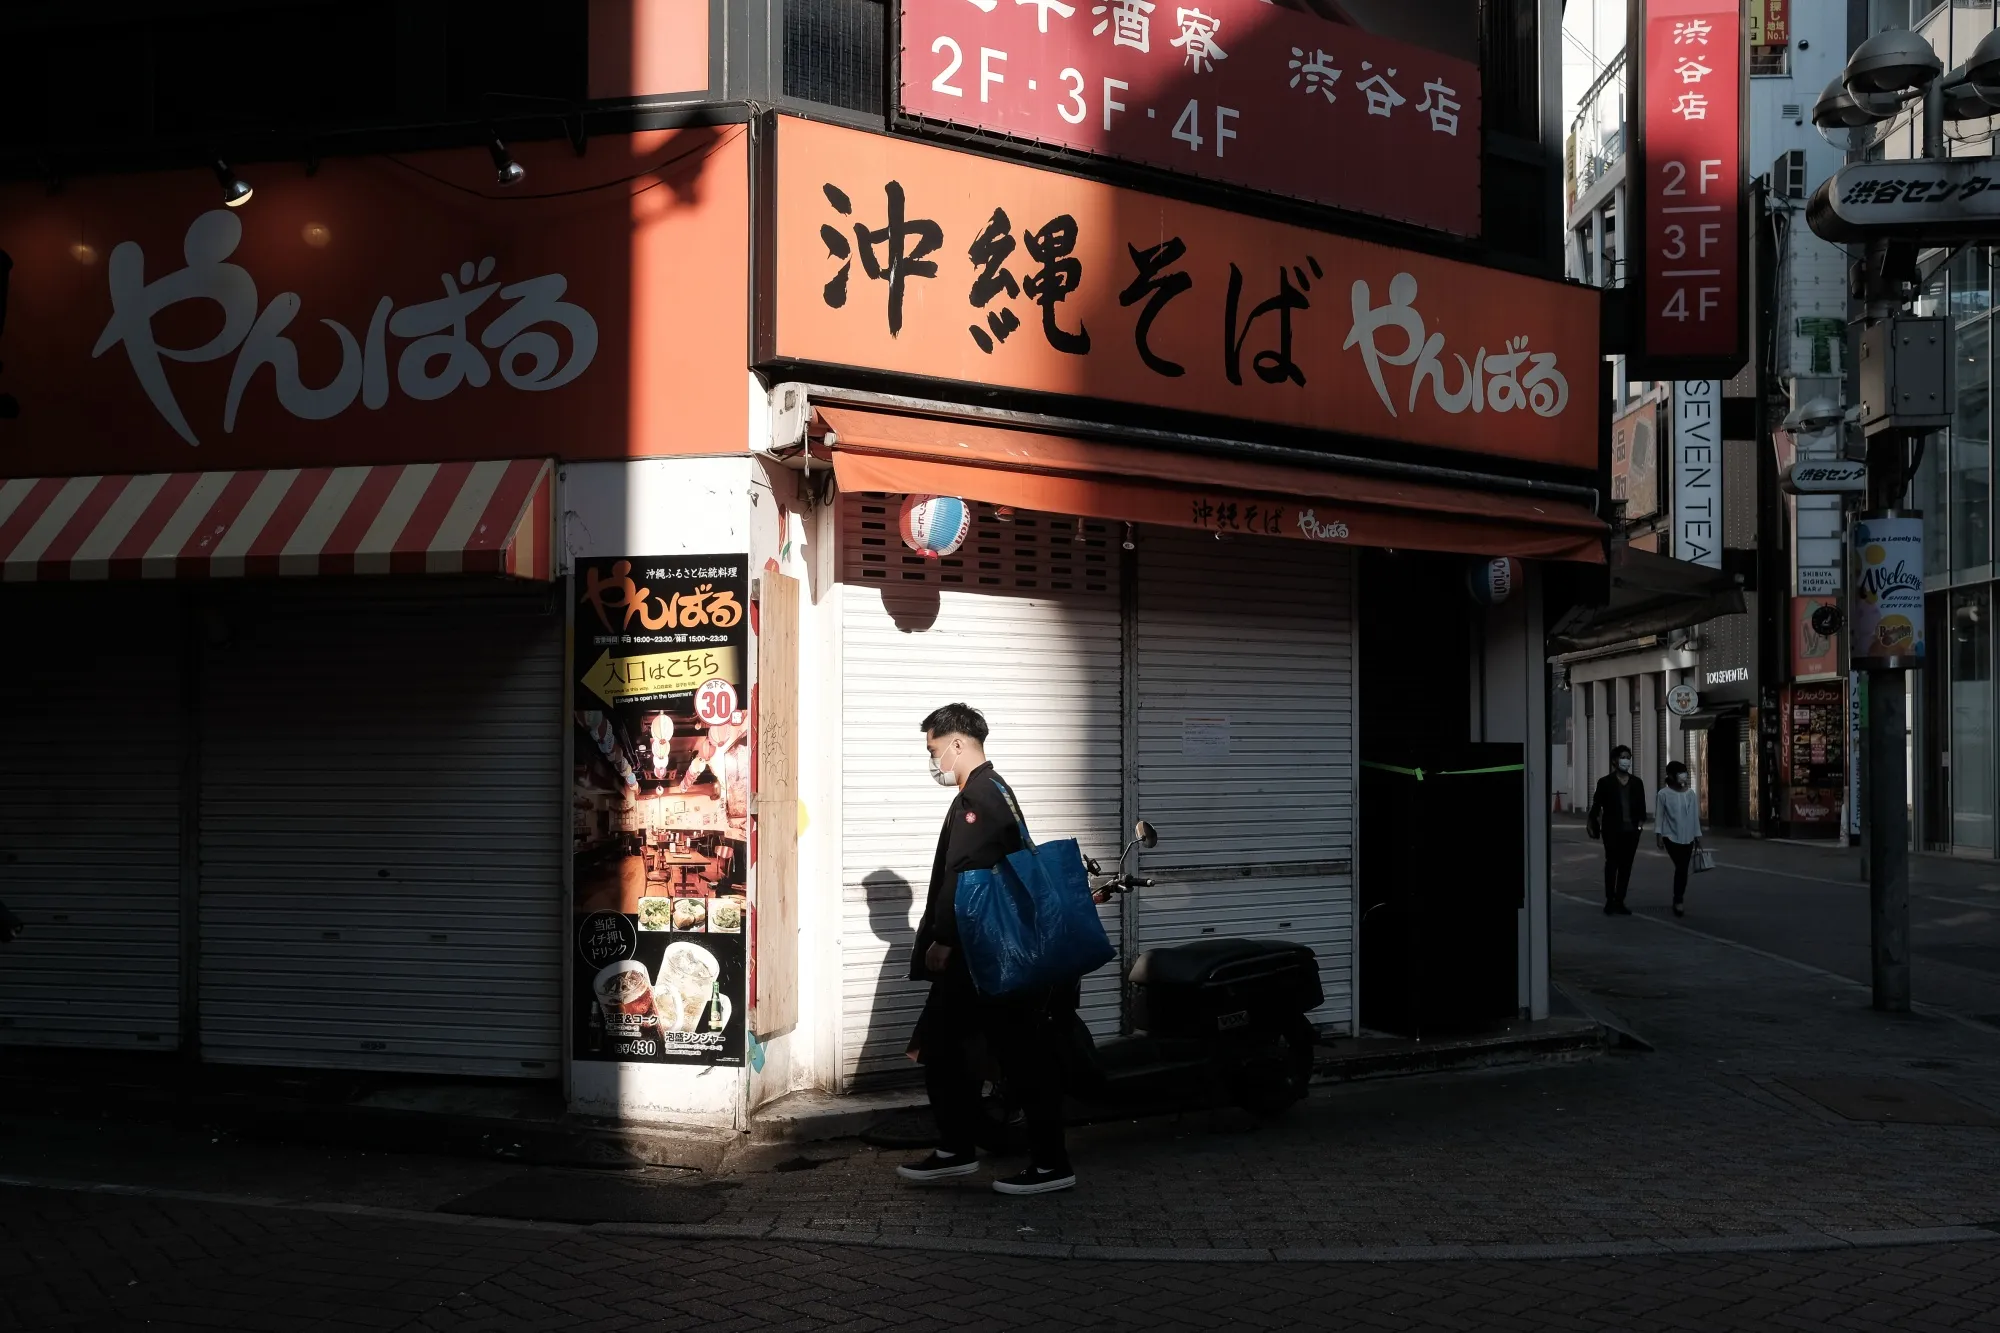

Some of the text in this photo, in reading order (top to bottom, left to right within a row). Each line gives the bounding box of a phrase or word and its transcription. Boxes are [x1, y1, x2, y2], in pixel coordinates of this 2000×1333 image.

[1768, 31, 1785, 40] No.1
[1672, 19, 1713, 120] 渋谷店
[1289, 46, 1461, 136] 渋谷店
[1662, 159, 1722, 196] 2F
[1661, 223, 1721, 260] 3F
[820, 180, 1324, 388] 沖縄そば
[1661, 287, 1721, 322] 4F
[92, 209, 599, 447] やんばる
[1342, 272, 1569, 417] やんばる
[1684, 380, 1711, 562] SEVEN TEA
[1192, 498, 1349, 539] 沖縄そば やんばる
[645, 566, 738, 580] 沖縄ふるさと伝統料理
[1492, 560, 1509, 594] Orion
[1860, 559, 1922, 599] Welcome
[580, 560, 743, 634] やんばる
[603, 652, 719, 687] 入口はこちら
[1718, 669, 1736, 683] SEVEN
[1737, 668, 1748, 681] TEA
[701, 691, 730, 718] 30
[588, 930, 626, 946] イチ押し
[593, 916, 616, 932] 当店
[592, 943, 627, 960] ドリンク
